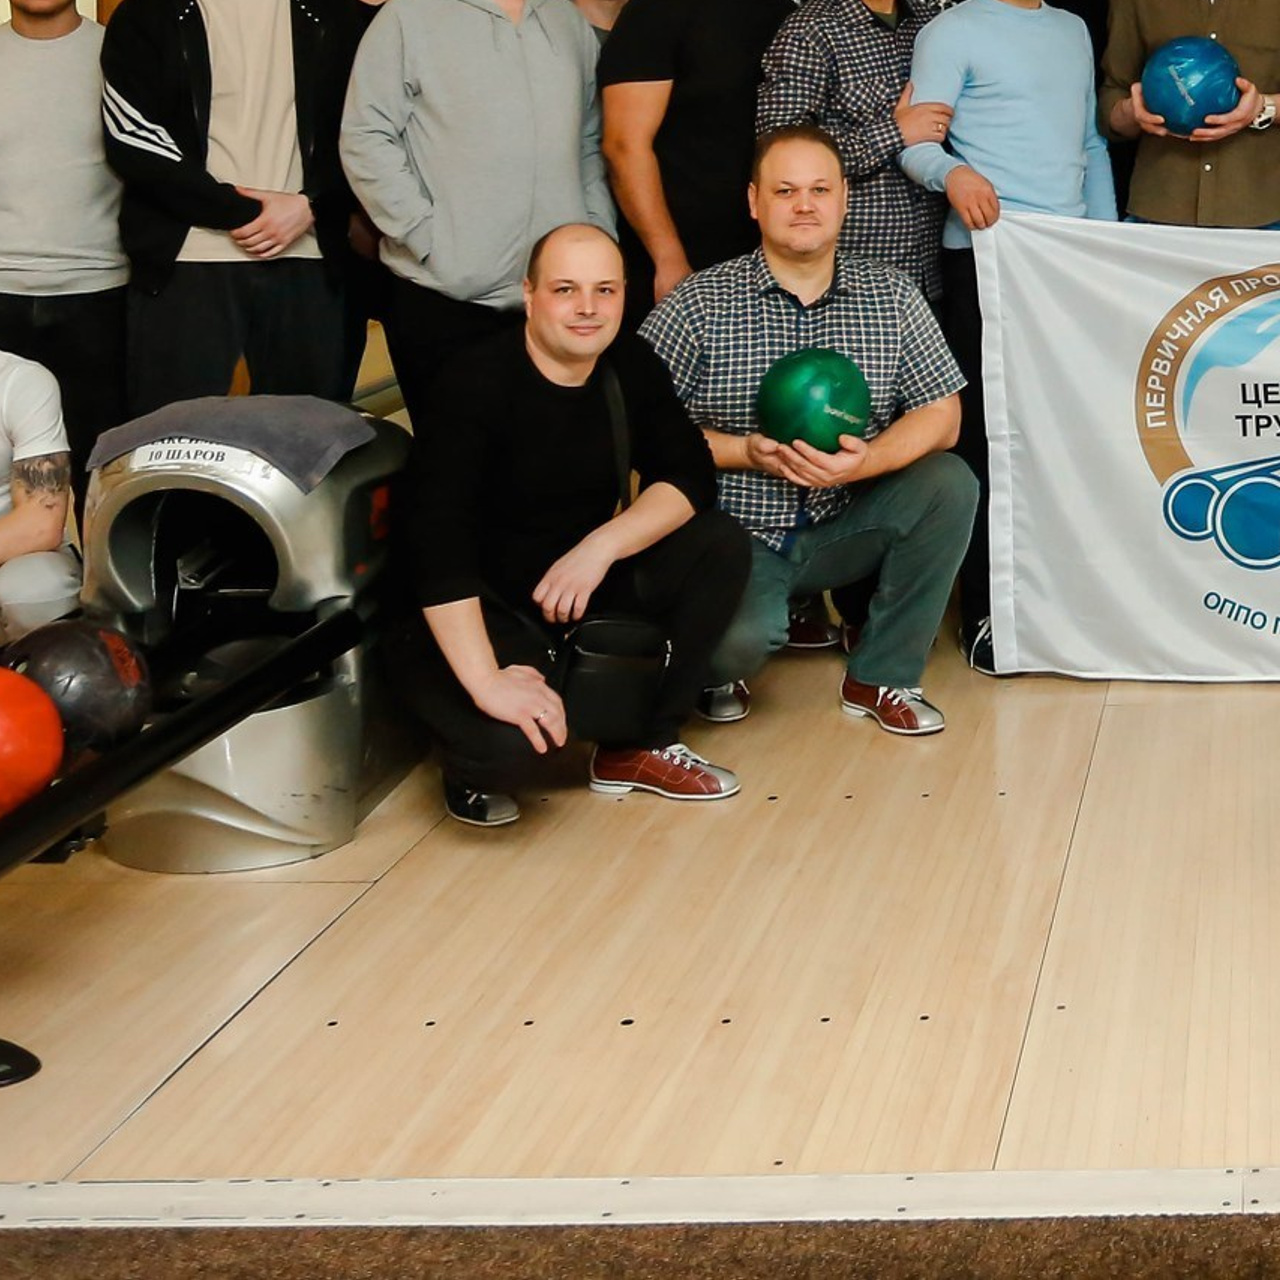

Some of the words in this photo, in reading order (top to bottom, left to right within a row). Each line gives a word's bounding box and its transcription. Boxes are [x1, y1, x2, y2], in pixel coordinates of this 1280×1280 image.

[1146, 286, 1230, 428] ПЕРВИЧНАЯ
[148, 450, 162, 462] 10
[166, 449, 226, 462] ШАРОВ
[1203, 591, 1267, 630] ОППО
